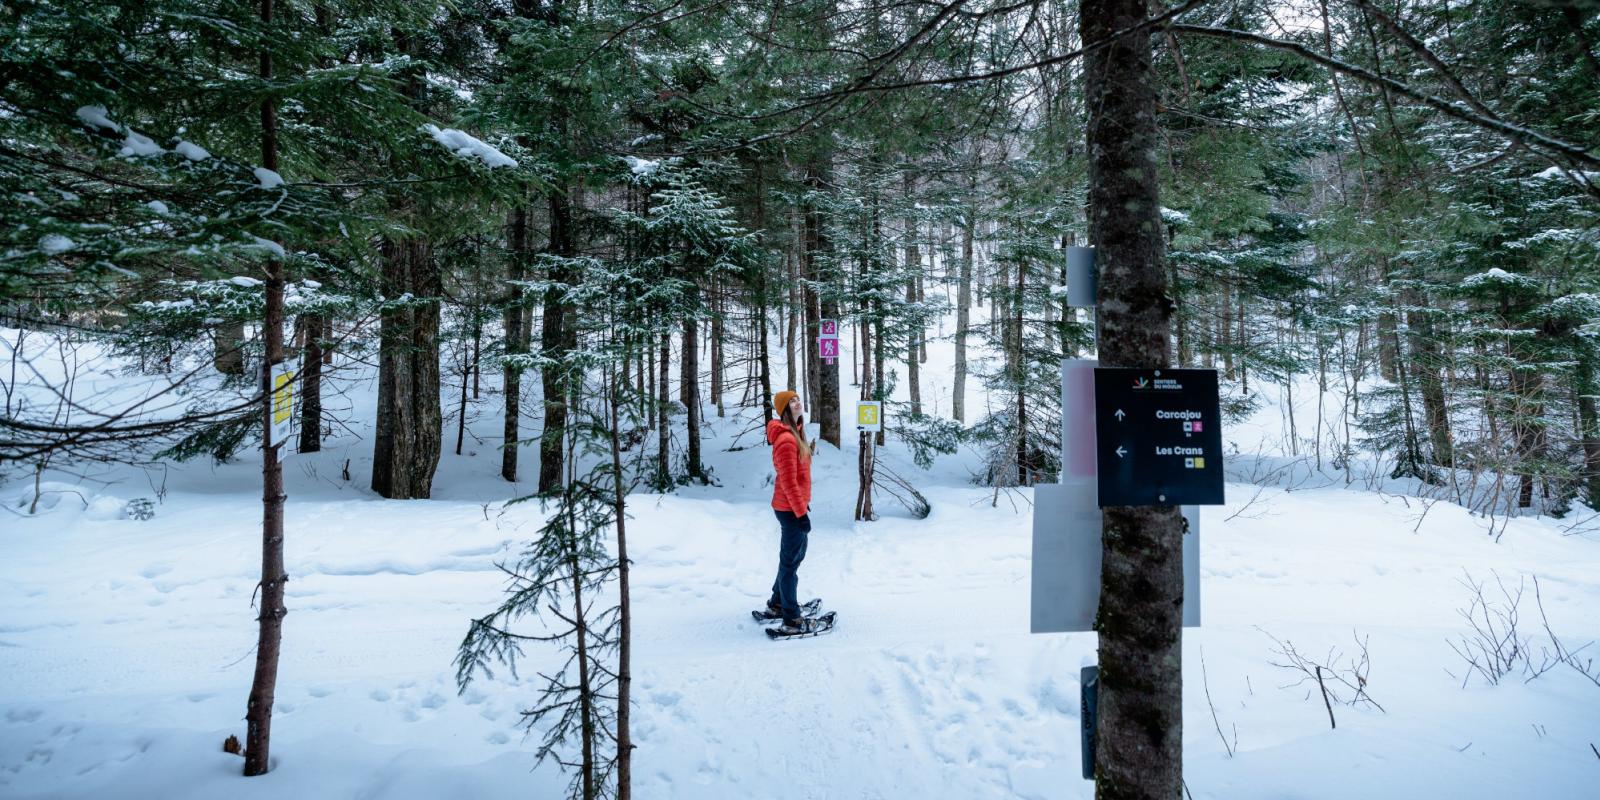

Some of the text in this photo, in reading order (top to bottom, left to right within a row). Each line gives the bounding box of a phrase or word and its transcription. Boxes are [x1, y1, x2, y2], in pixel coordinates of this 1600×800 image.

[1156, 409, 1202, 420] Carcajou
[1156, 446, 1203, 455] Les Crans
